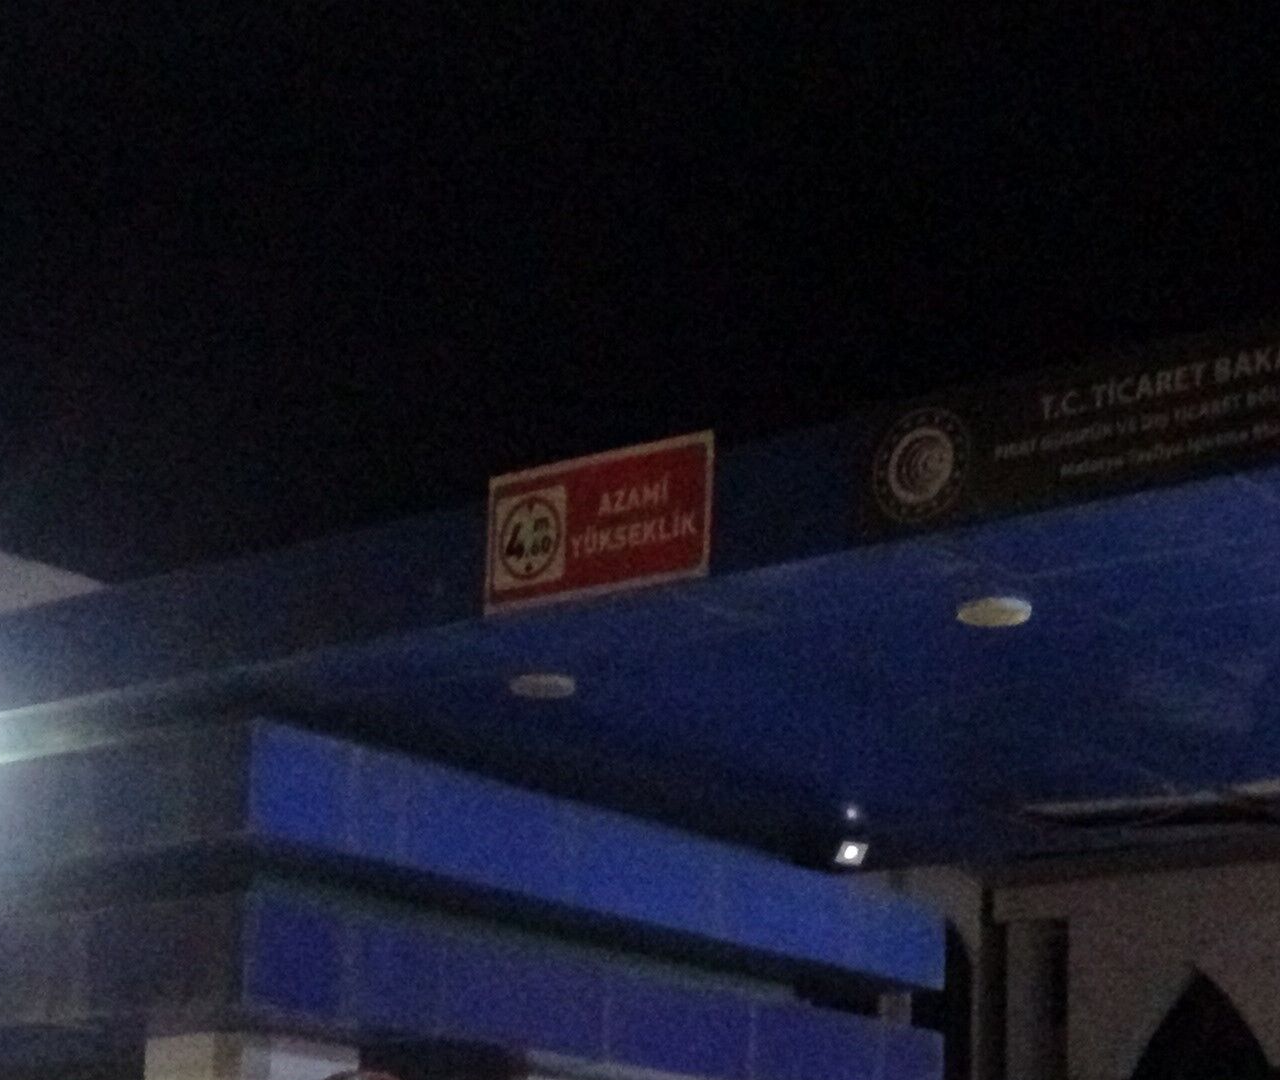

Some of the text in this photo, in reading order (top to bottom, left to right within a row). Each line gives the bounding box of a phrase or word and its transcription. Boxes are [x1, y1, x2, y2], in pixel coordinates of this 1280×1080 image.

[1039, 385, 1086, 421] T.C.
[1091, 358, 1206, 410] TİCARET
[1173, 393, 1240, 424] TİCARET
[597, 474, 670, 515] AZAMİ
[570, 509, 698, 557] YÜKSEKLİK
